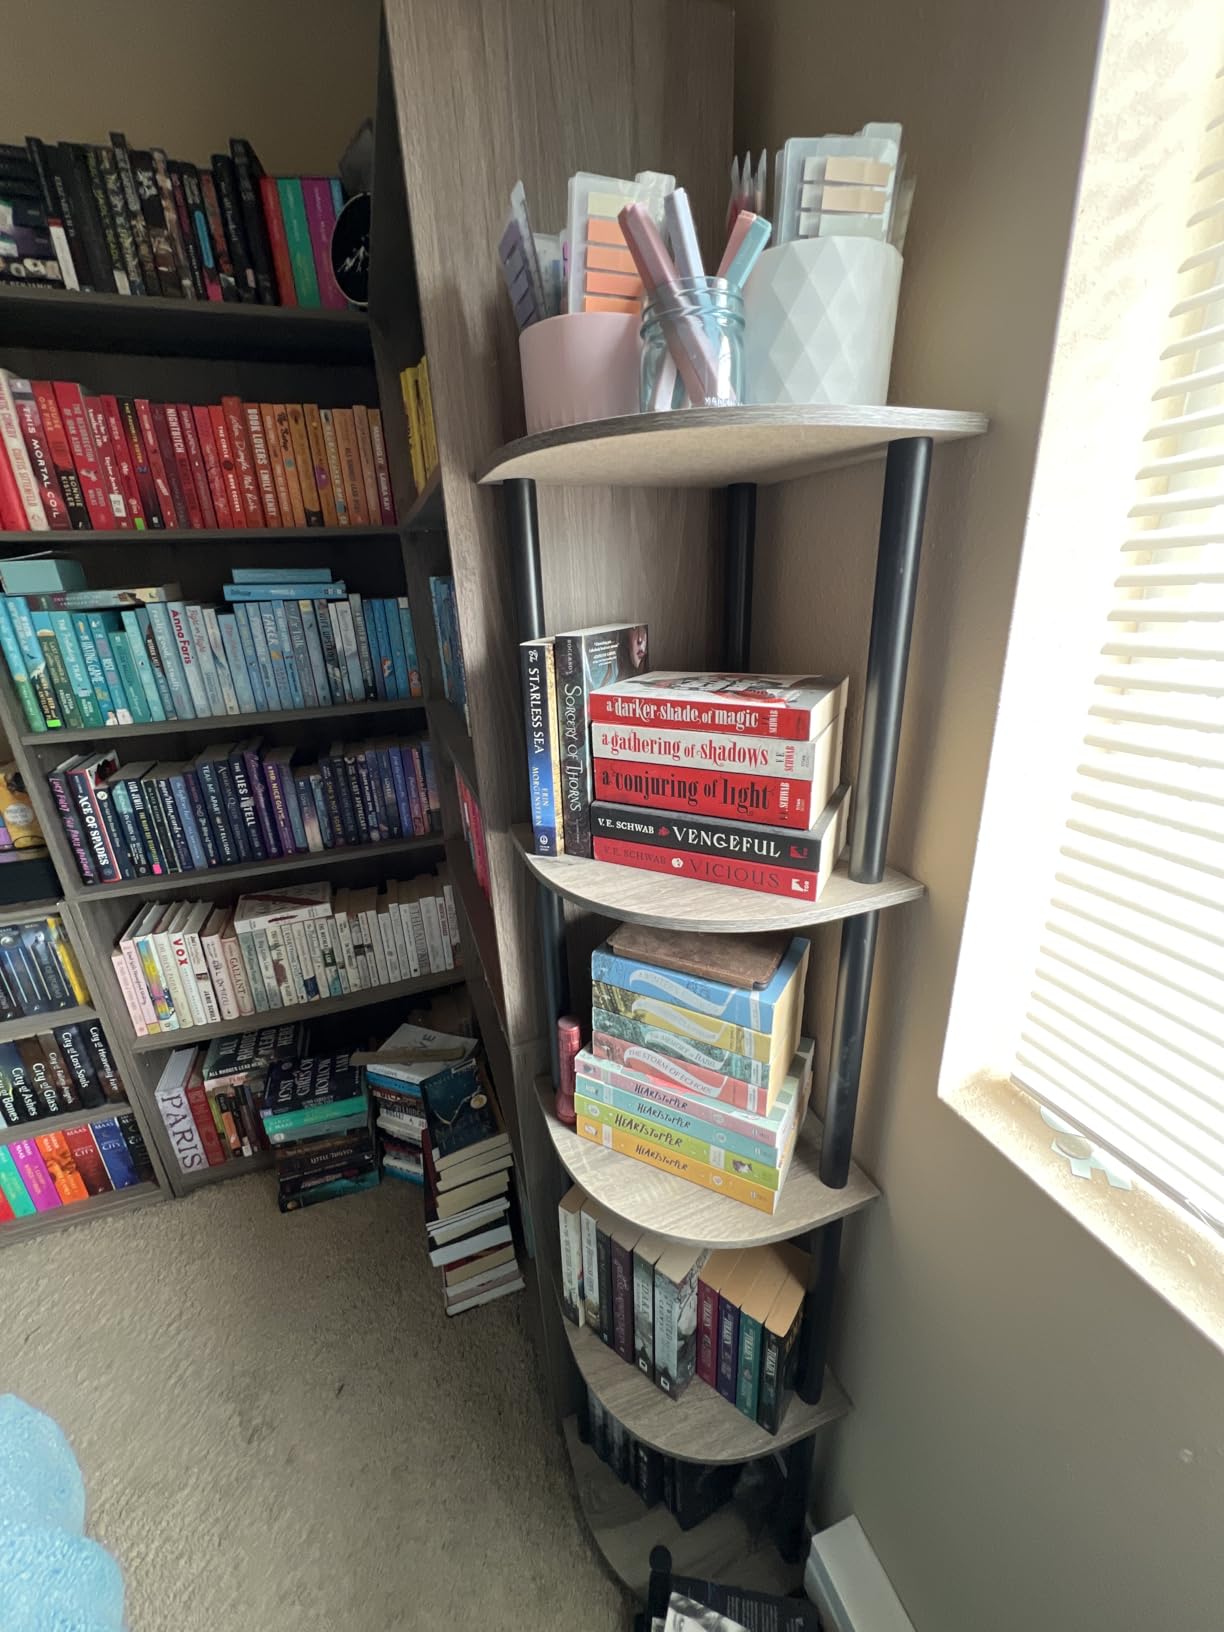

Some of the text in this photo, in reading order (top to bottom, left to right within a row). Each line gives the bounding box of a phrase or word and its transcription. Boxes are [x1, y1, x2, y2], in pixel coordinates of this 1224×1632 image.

[166, 408, 184, 453] NIGHTBITCH
[248, 408, 260, 432] BOOK
[23, 406, 60, 518] THIS MORTAL COIL
[252, 434, 268, 464] LOVERS
[61, 476, 74, 507] KISTLER
[68, 476, 82, 507] BONNIE
[260, 470, 272, 492] EMILY
[264, 493, 276, 516] HENRY
[170, 610, 192, 664] Anna Faris
[264, 614, 280, 646] FAKER
[58, 619, 82, 681] THE TRAP
[81, 640, 104, 684] HATING GAME
[102, 658, 114, 672] BEST
[528, 668, 544, 754] STARLESS SEA
[606, 697, 759, 732] a darker shade of magic
[768, 710, 778, 734] SCHWAB
[564, 684, 584, 812] SORCERY OF THORNS
[602, 731, 768, 768] a gathering of shadows
[784, 746, 795, 772] SCHWAB
[48, 777, 63, 794] LUCY
[128, 781, 144, 810] LISA JEWELL
[206, 783, 216, 794] ME
[272, 783, 282, 800] NICE
[532, 766, 544, 826] MORGENSTERN
[542, 788, 550, 807] ERIN
[602, 770, 770, 816] a conjuring of light
[779, 782, 790, 808] SCHWAB
[78, 795, 92, 816] ACE
[210, 794, 222, 814] APART
[235, 774, 248, 794] LIES
[243, 807, 256, 827] TELL
[330, 800, 338, 812] NOT
[85, 816, 99, 829] OF
[90, 829, 110, 866] SPADES
[220, 832, 230, 855] ELLISON
[597, 817, 782, 858] V. E. SCHWAB VENGEFUL
[624, 849, 666, 864] SCHWAB
[688, 858, 780, 888] VICIOUS
[173, 938, 188, 966] VOX
[230, 958, 246, 994] GALLANT
[49, 1052, 58, 1065] City
[62, 1032, 90, 1088] City of Lost Souls
[90, 1026, 100, 1042] City
[98, 1048, 114, 1078] Heavenly
[110, 1078, 120, 1091] Fire
[220, 1038, 239, 1056] ALL
[219, 1066, 238, 1074] RHODES
[315, 1058, 331, 1095] HOLLOW
[628, 1050, 641, 1058] THE
[642, 1051, 666, 1070] STORM
[669, 1066, 680, 1076] OF
[12, 1067, 38, 1117] City of Ashes
[33, 1062, 60, 1112] City of Glass
[278, 1080, 294, 1102] LOST
[294, 1070, 312, 1096] GIRLS
[2, 1094, 20, 1122] Bones
[66, 1127, 88, 1136] MAAS
[94, 1122, 114, 1130] MAAS
[161, 1094, 202, 1170] PARIS
[74, 1148, 94, 1158] CITY
[102, 1142, 120, 1150] CITY
